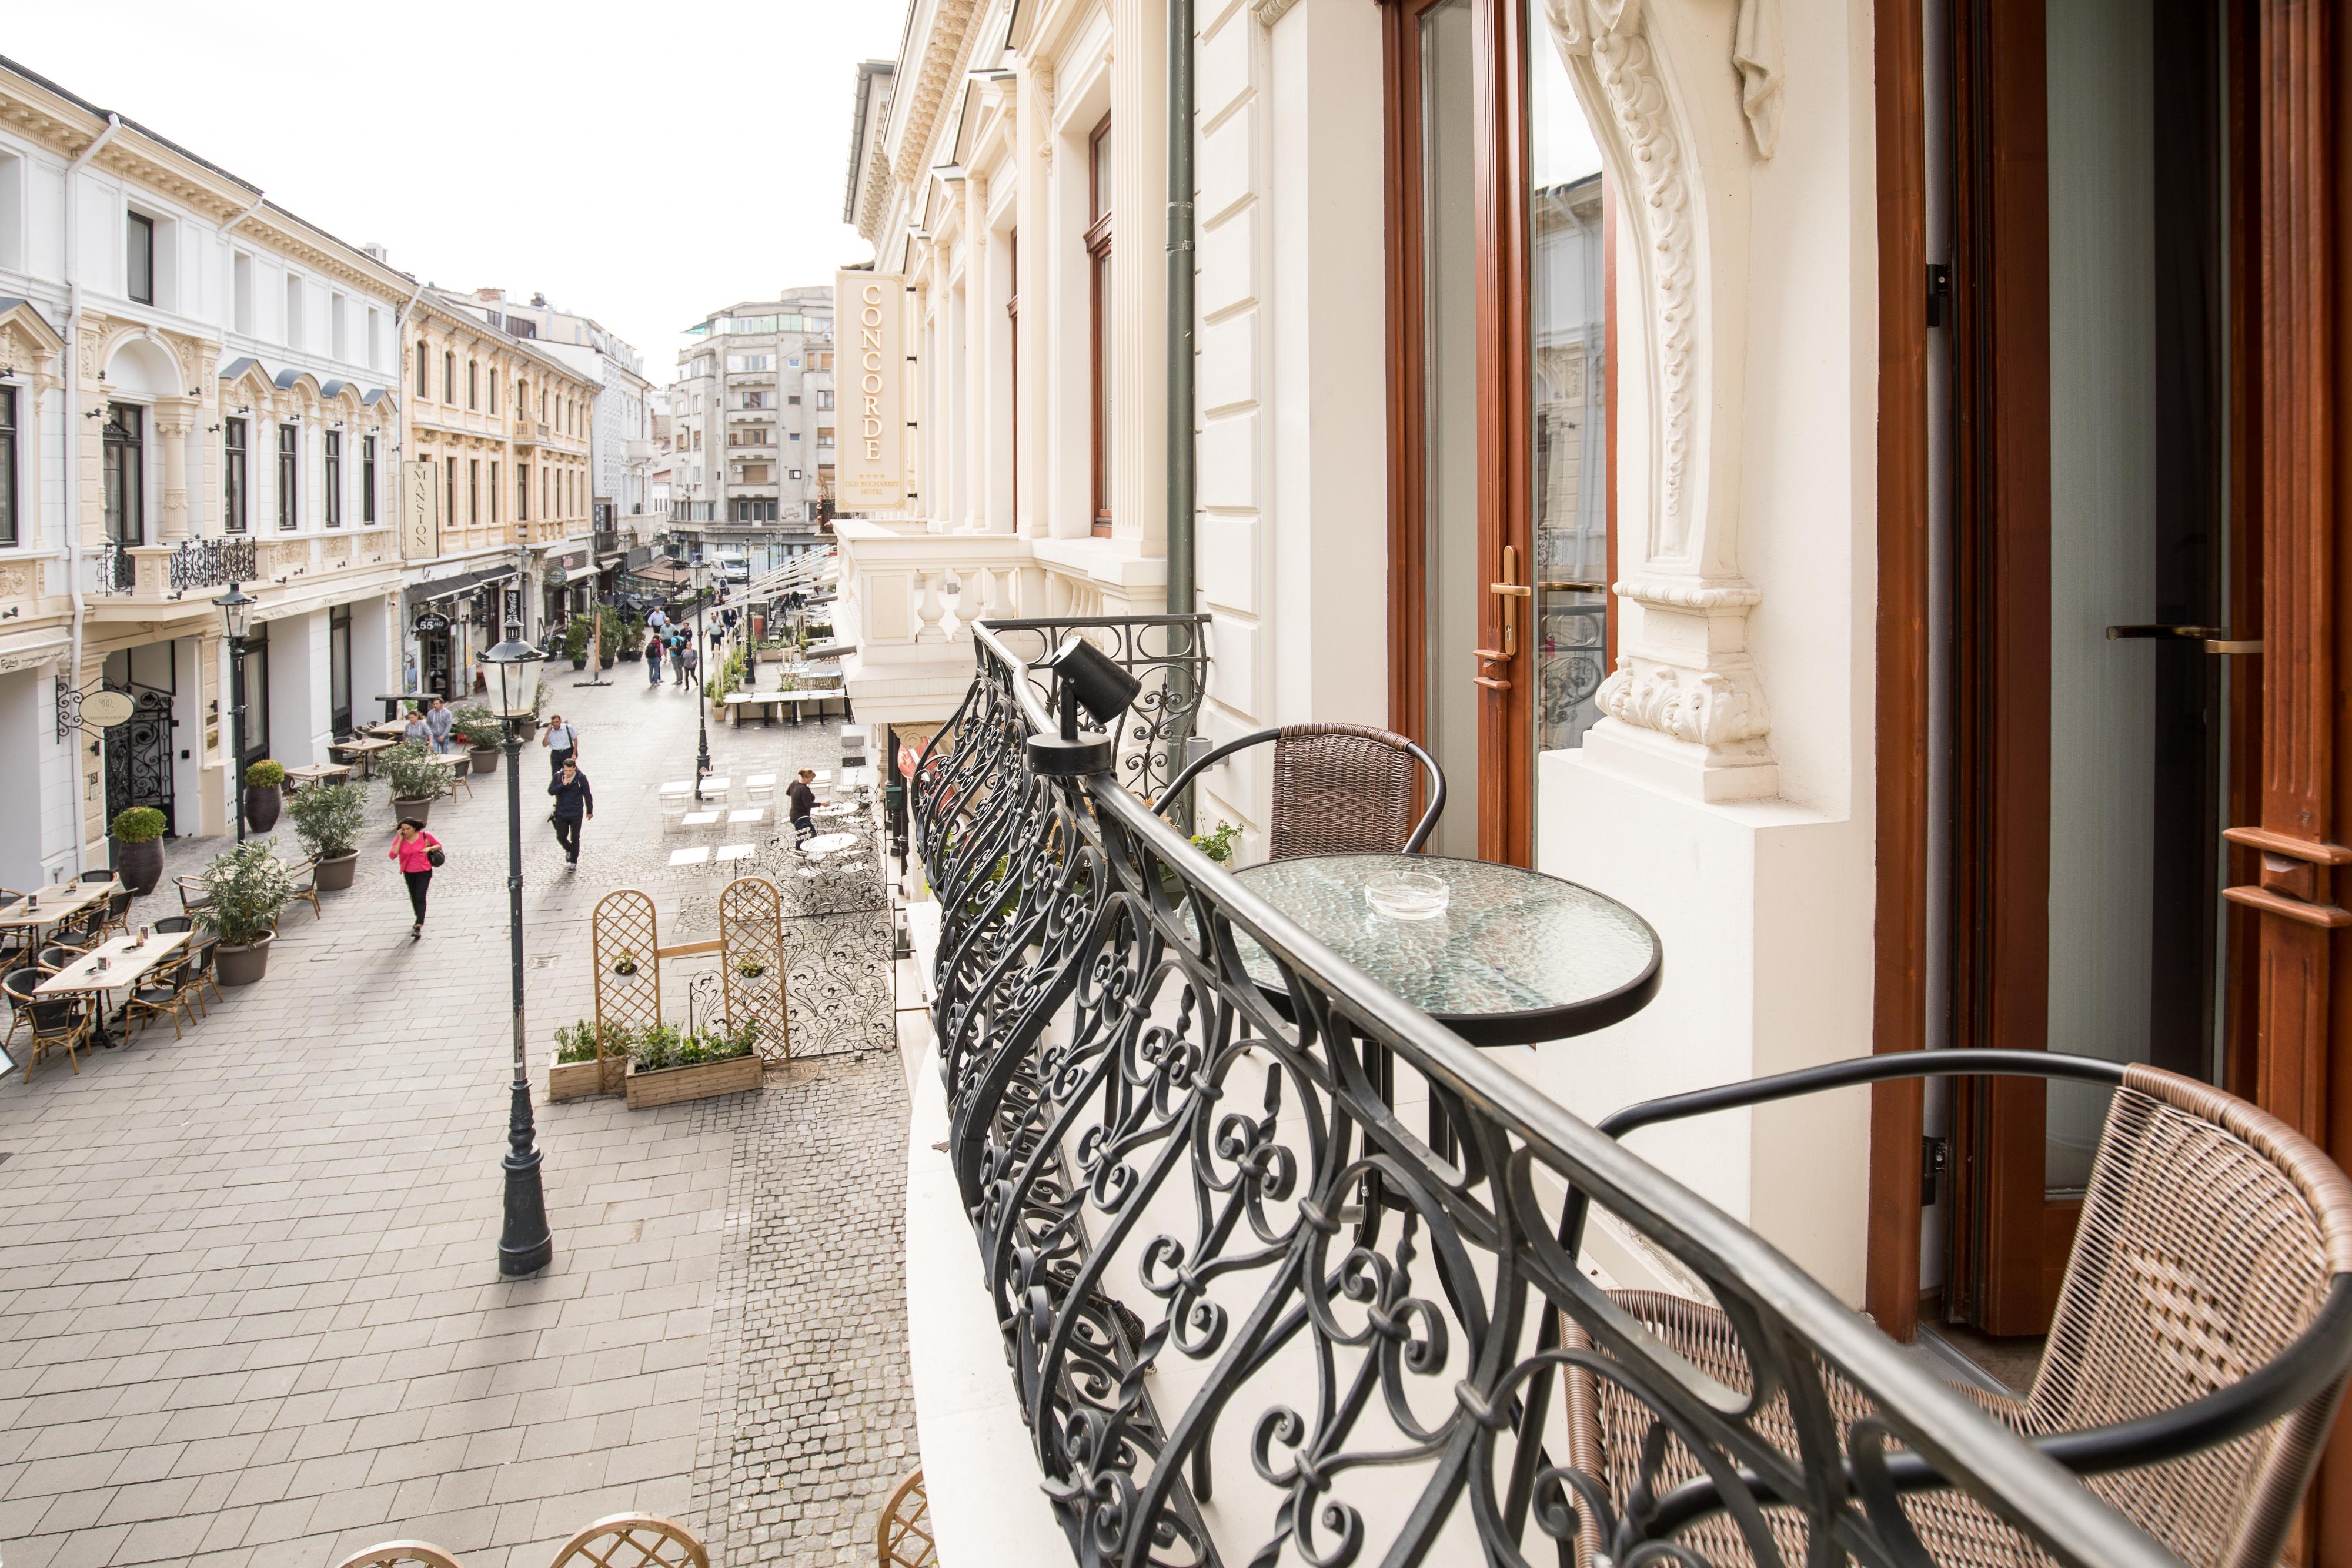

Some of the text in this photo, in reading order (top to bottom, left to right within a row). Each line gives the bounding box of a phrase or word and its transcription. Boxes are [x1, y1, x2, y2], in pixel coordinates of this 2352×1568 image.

[861, 285, 883, 460] CONCORDE
[413, 470, 426, 546] MANSION
[420, 621, 434, 630] 55
